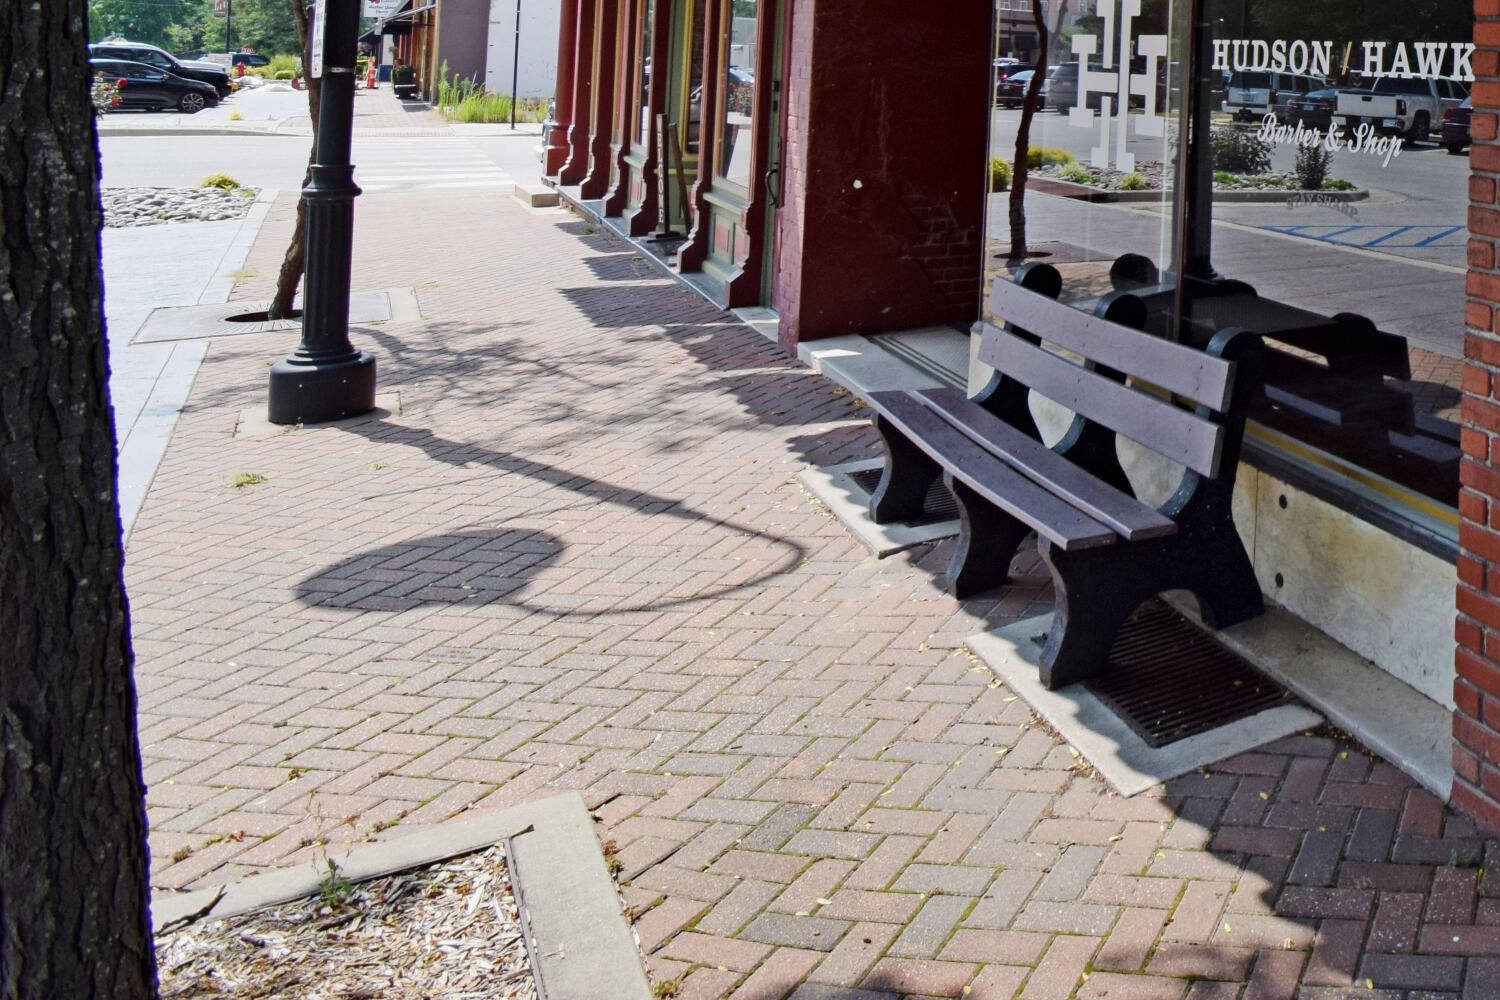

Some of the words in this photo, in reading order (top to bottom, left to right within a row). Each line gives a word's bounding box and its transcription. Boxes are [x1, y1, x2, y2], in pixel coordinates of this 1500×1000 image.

[1211, 39, 1334, 76] HUDSON
[1361, 41, 1477, 82] HAWK
[1256, 111, 1321, 148] Barber
[1324, 121, 1345, 152] &
[1347, 122, 1406, 168] Shop
[1286, 191, 1315, 210] STAY
[1316, 193, 1360, 222] SHARP
